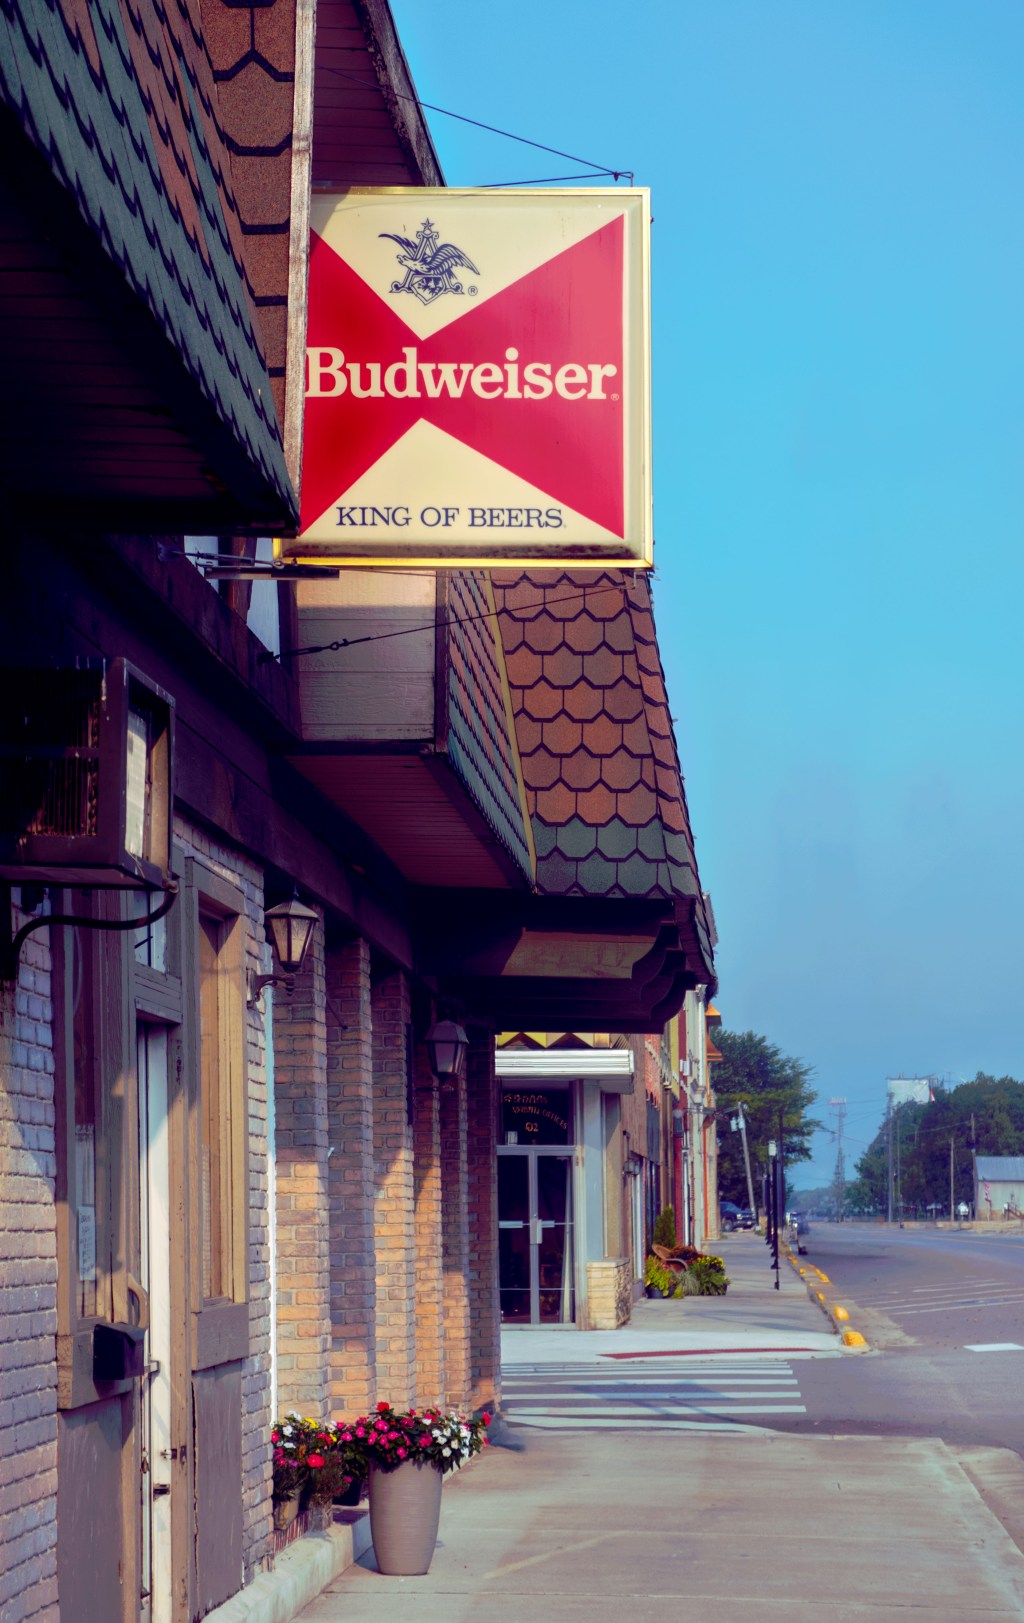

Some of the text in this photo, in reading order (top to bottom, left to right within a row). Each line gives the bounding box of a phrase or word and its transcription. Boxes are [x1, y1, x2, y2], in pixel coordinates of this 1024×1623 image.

[305, 346, 617, 400] Budweiser
[336, 507, 563, 528] KING OF BEERS
